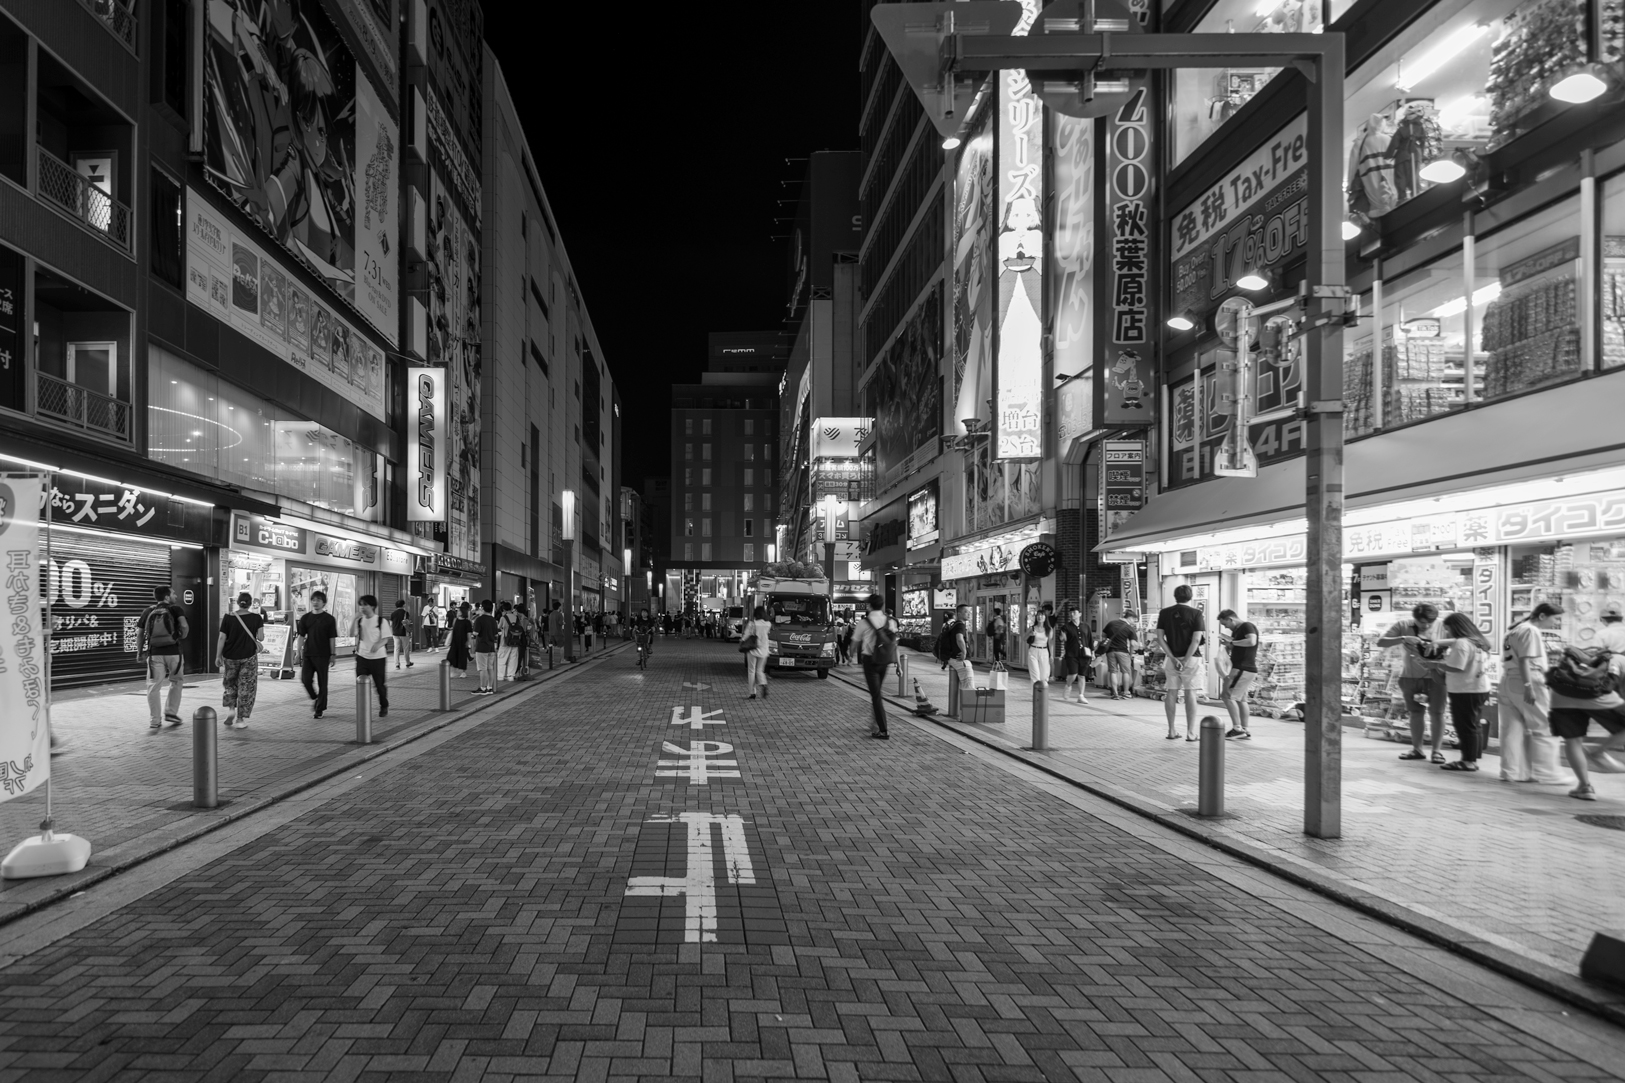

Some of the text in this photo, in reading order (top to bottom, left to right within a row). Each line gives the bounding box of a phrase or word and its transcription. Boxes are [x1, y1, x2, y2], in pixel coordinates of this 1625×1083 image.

[1176, 184, 1227, 252] 免税
[363, 250, 382, 287] 7.31
[1417, 324, 1440, 333] TikTok
[417, 372, 435, 514] GAMERS
[1106, 452, 1142, 460] フロア案内
[238, 524, 249, 536] B1
[819, 520, 845, 528] アム
[1463, 512, 1489, 542] 薬
[315, 537, 378, 564] GAMERS
[1024, 544, 1055, 557] SMOKER'S
[1243, 538, 1304, 564] ダイコク
[1349, 530, 1384, 553] 免税
[1478, 568, 1494, 634] ダイコク
